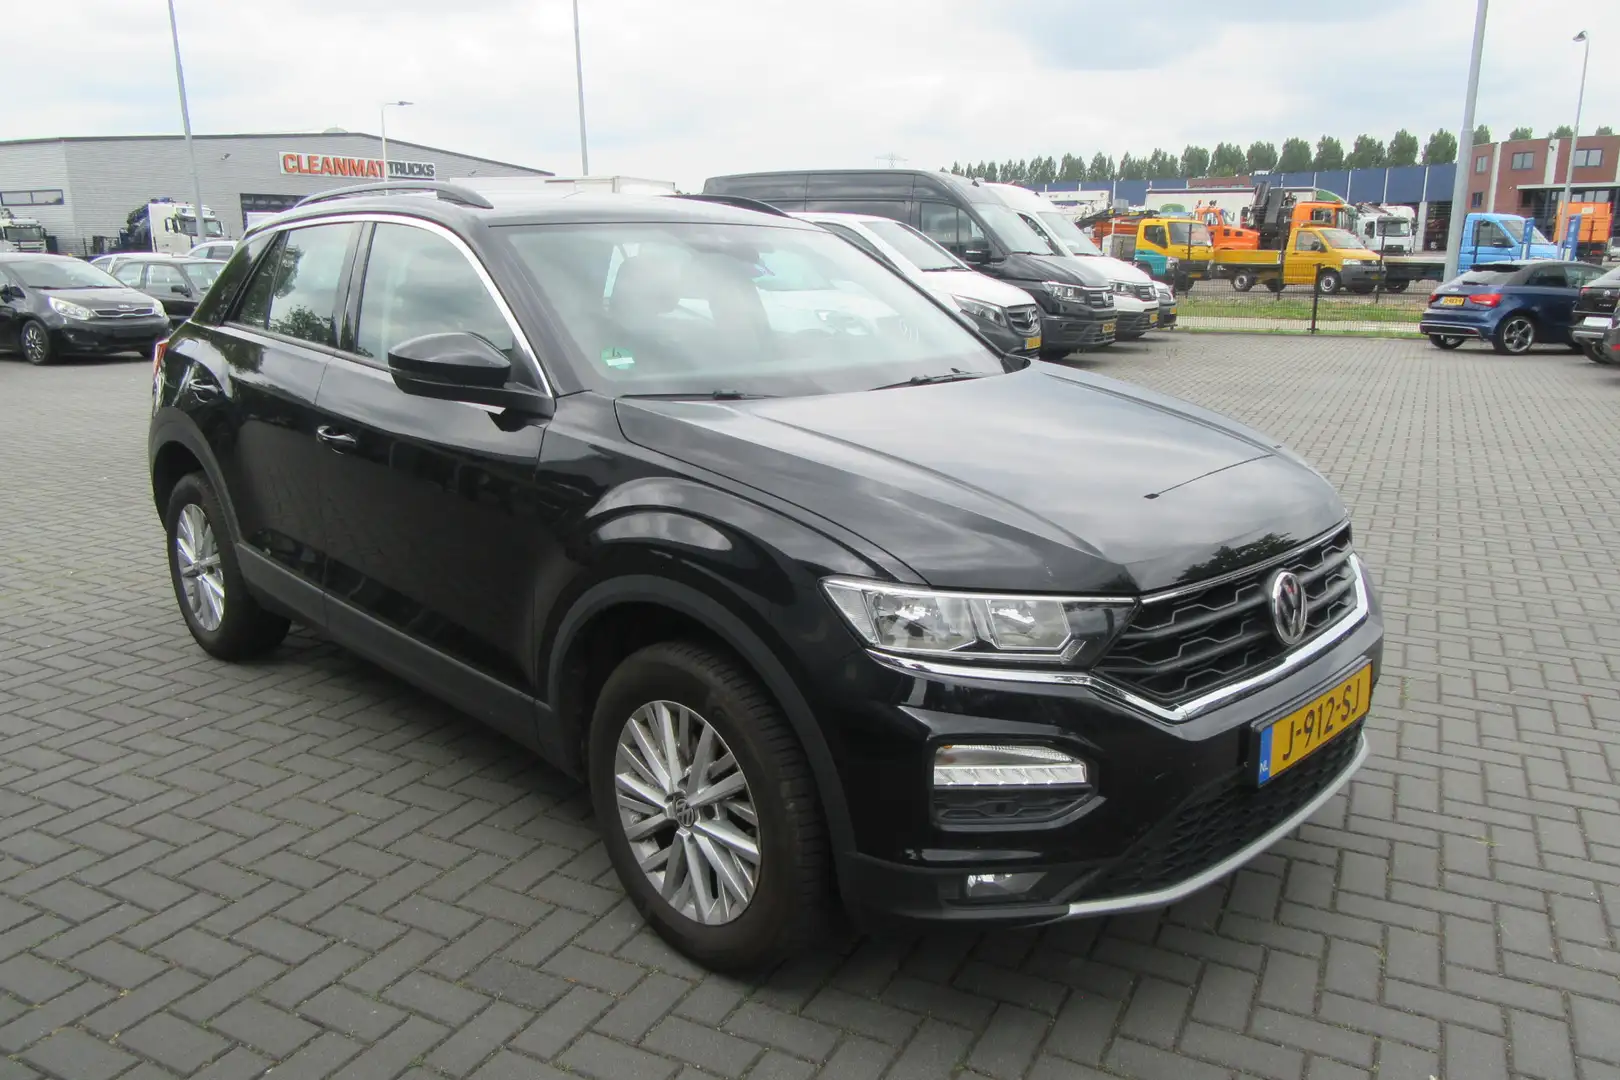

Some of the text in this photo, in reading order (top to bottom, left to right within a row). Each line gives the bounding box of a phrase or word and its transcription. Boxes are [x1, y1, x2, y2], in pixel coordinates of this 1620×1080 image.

[283, 154, 435, 178] CLEANMAT TRUCKS
[1282, 678, 1361, 762] J-912-SJ
[1259, 759, 1269, 774] NL
